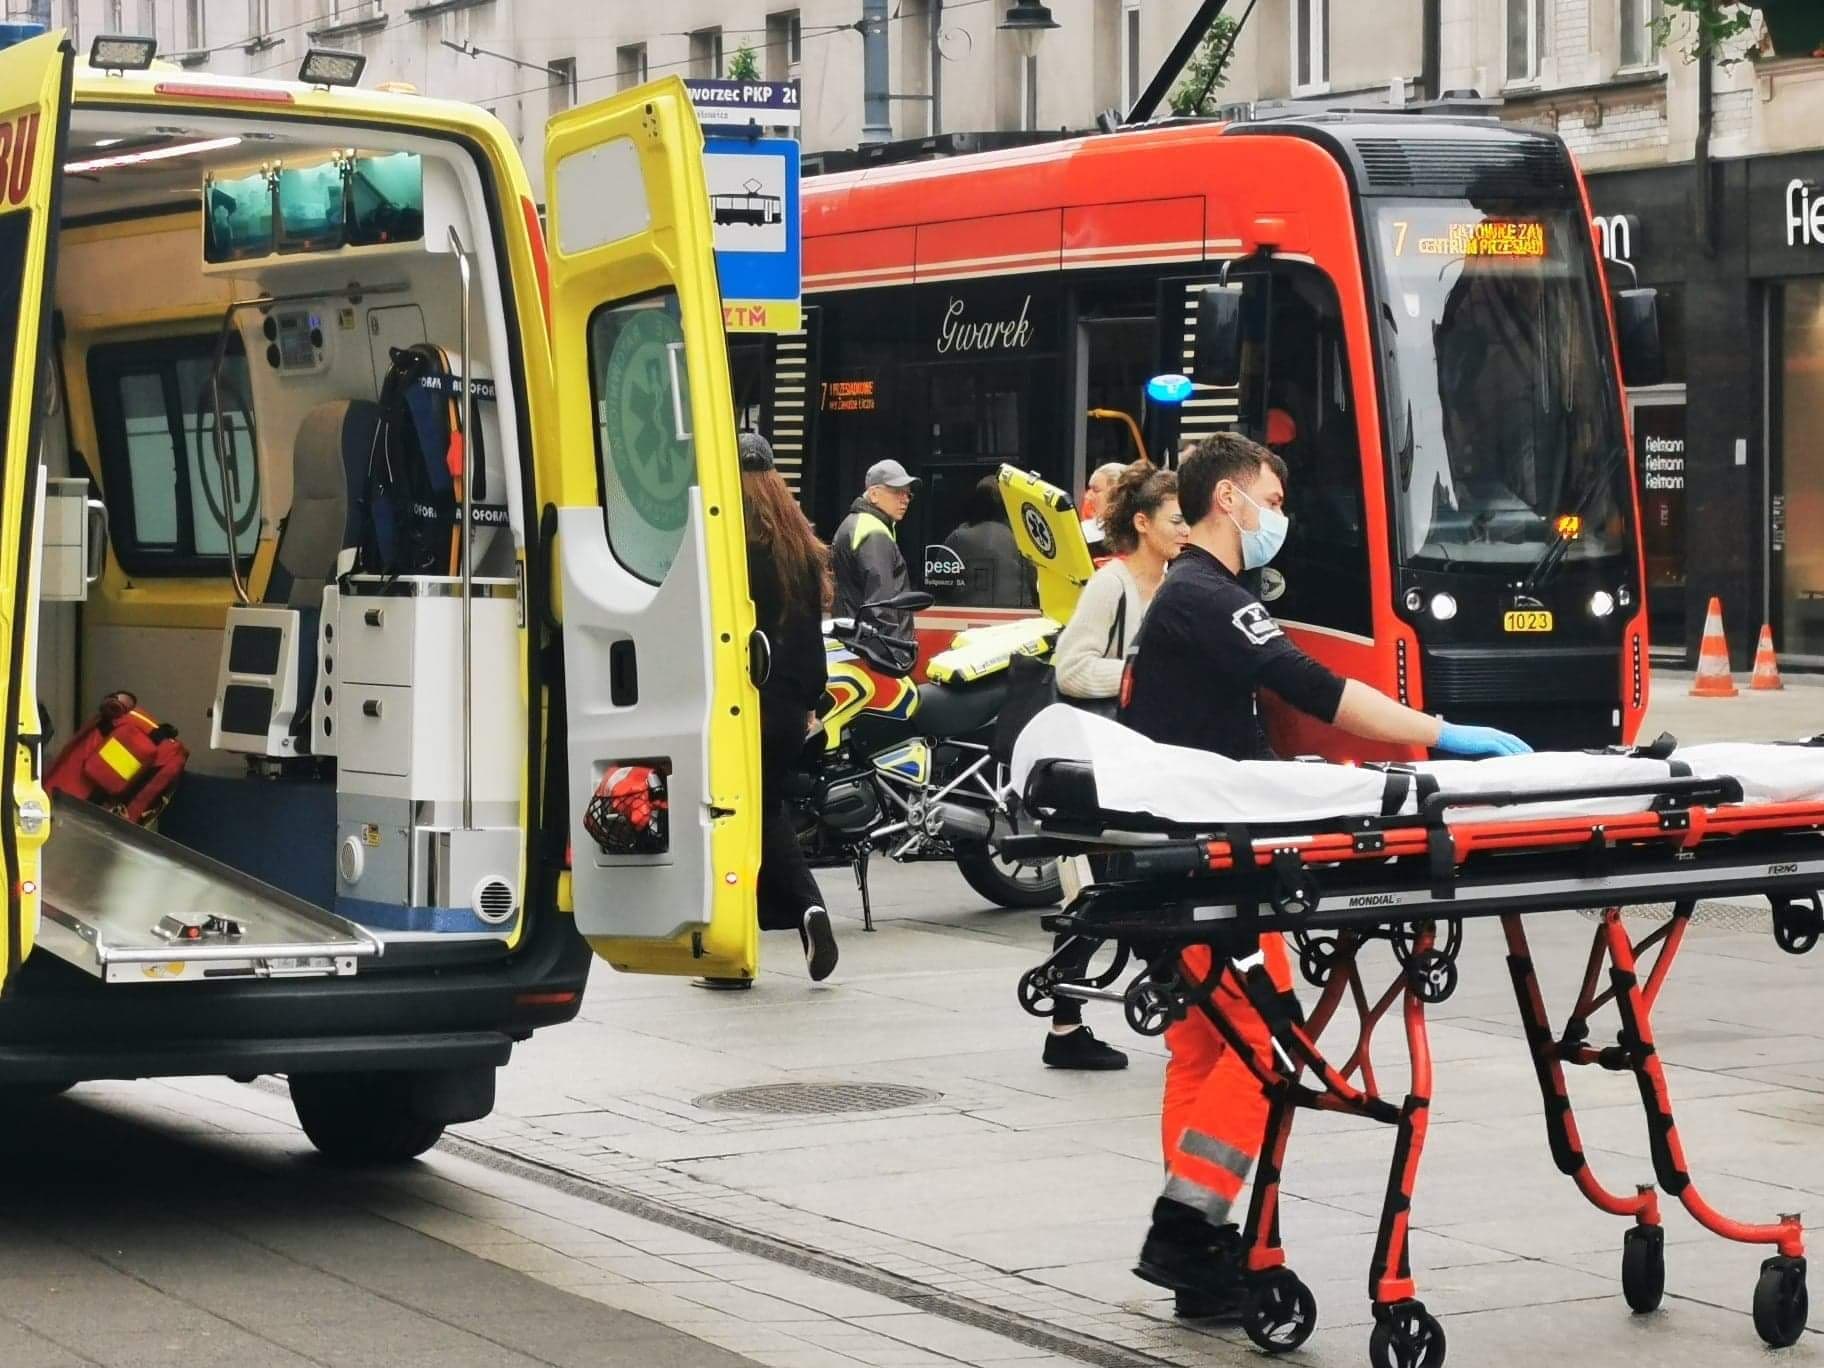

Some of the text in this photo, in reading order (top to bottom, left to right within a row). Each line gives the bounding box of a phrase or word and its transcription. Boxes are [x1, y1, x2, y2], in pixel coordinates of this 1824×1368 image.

[688, 87, 740, 102] worzec
[743, 86, 773, 102] PKP
[1392, 221, 1408, 257] 7
[1418, 238, 1477, 255] CENTRUM
[723, 304, 767, 327] ZTM
[937, 294, 1034, 354] Gwarek
[820, 382, 828, 412] 7
[924, 560, 961, 577] pesa
[1508, 613, 1548, 630] 1023
[1348, 894, 1395, 907] MONDIAL
